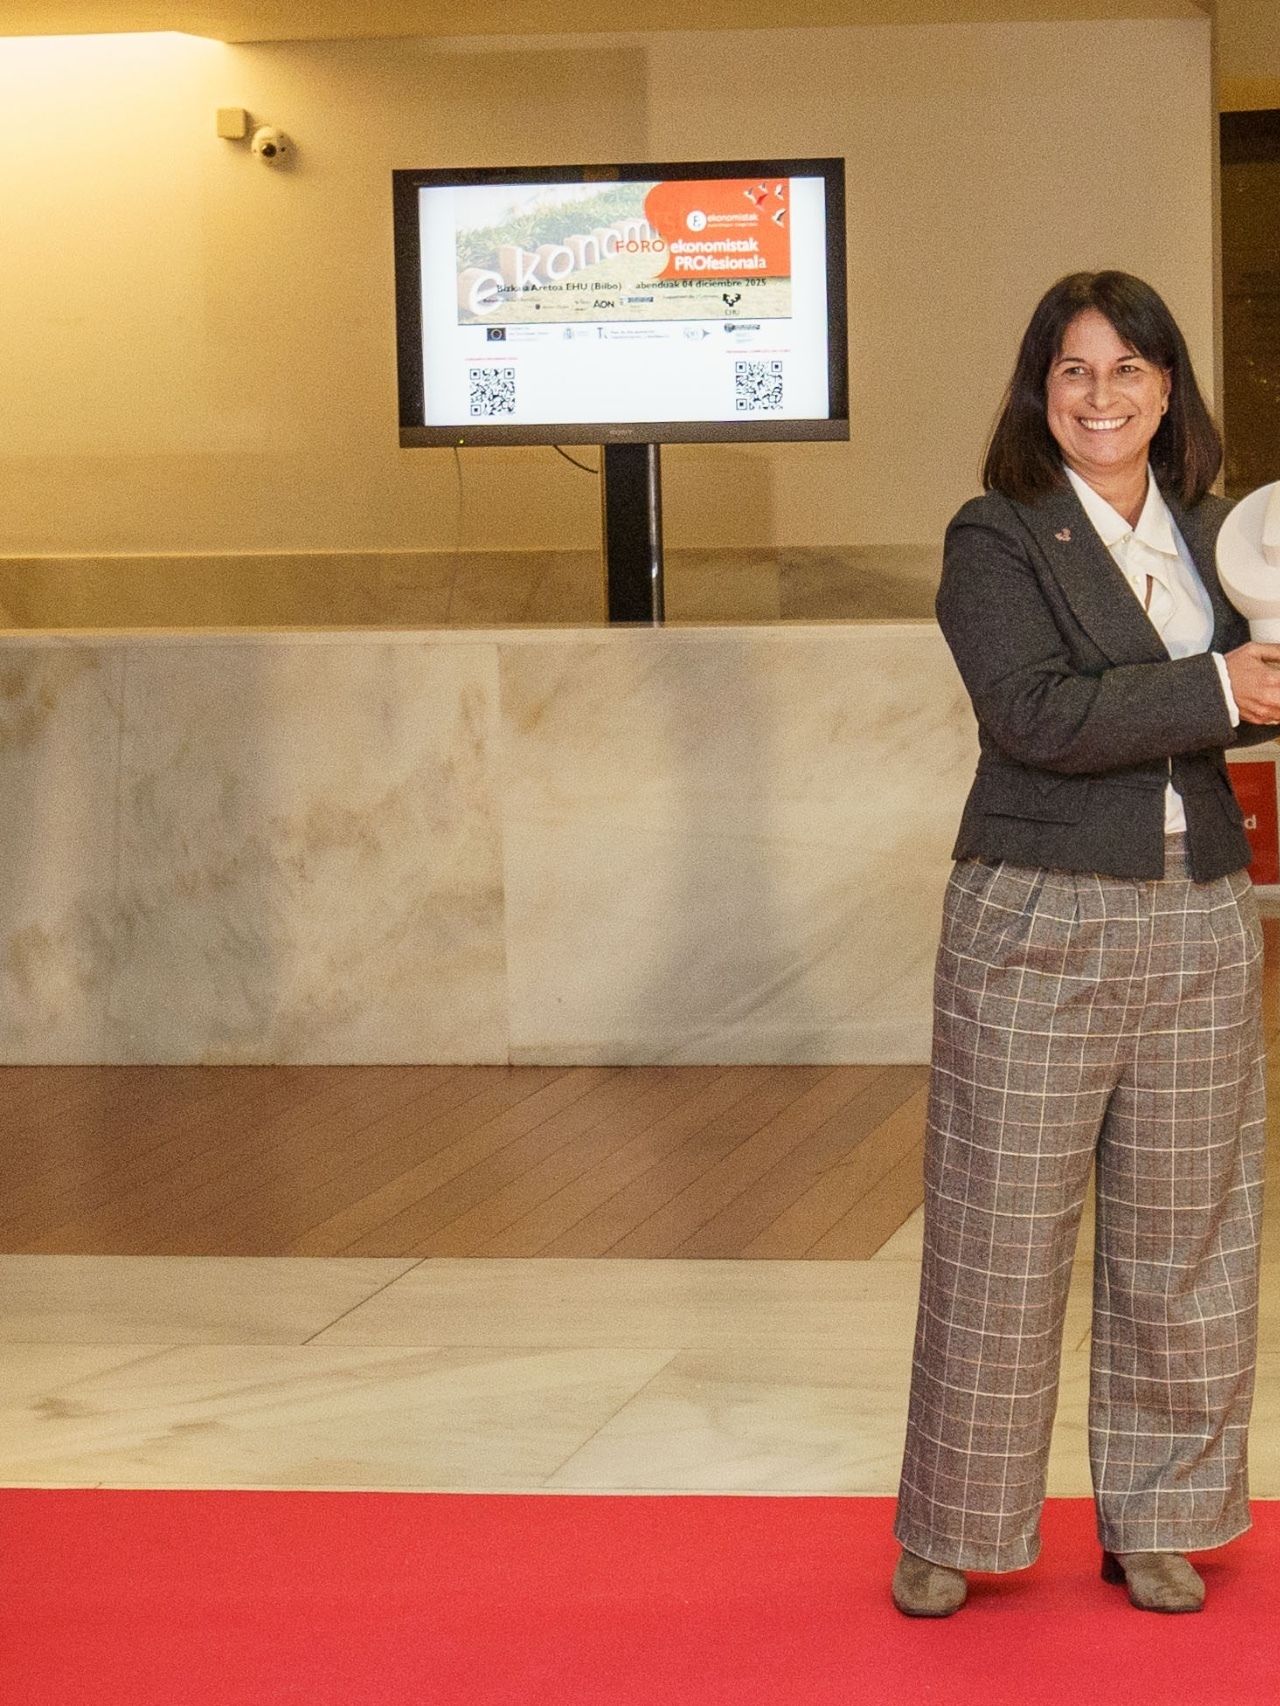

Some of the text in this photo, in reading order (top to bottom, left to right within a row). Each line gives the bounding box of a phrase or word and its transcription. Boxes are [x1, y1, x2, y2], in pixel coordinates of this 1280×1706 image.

[615, 238, 759, 254] FORO ekonomistak
[674, 256, 767, 271] PROfesionala
[497, 278, 767, 294] Bizkia Aretoa EHU (Bilbo) abenduak 04 diciembre 2025
[592, 300, 615, 309] AON
